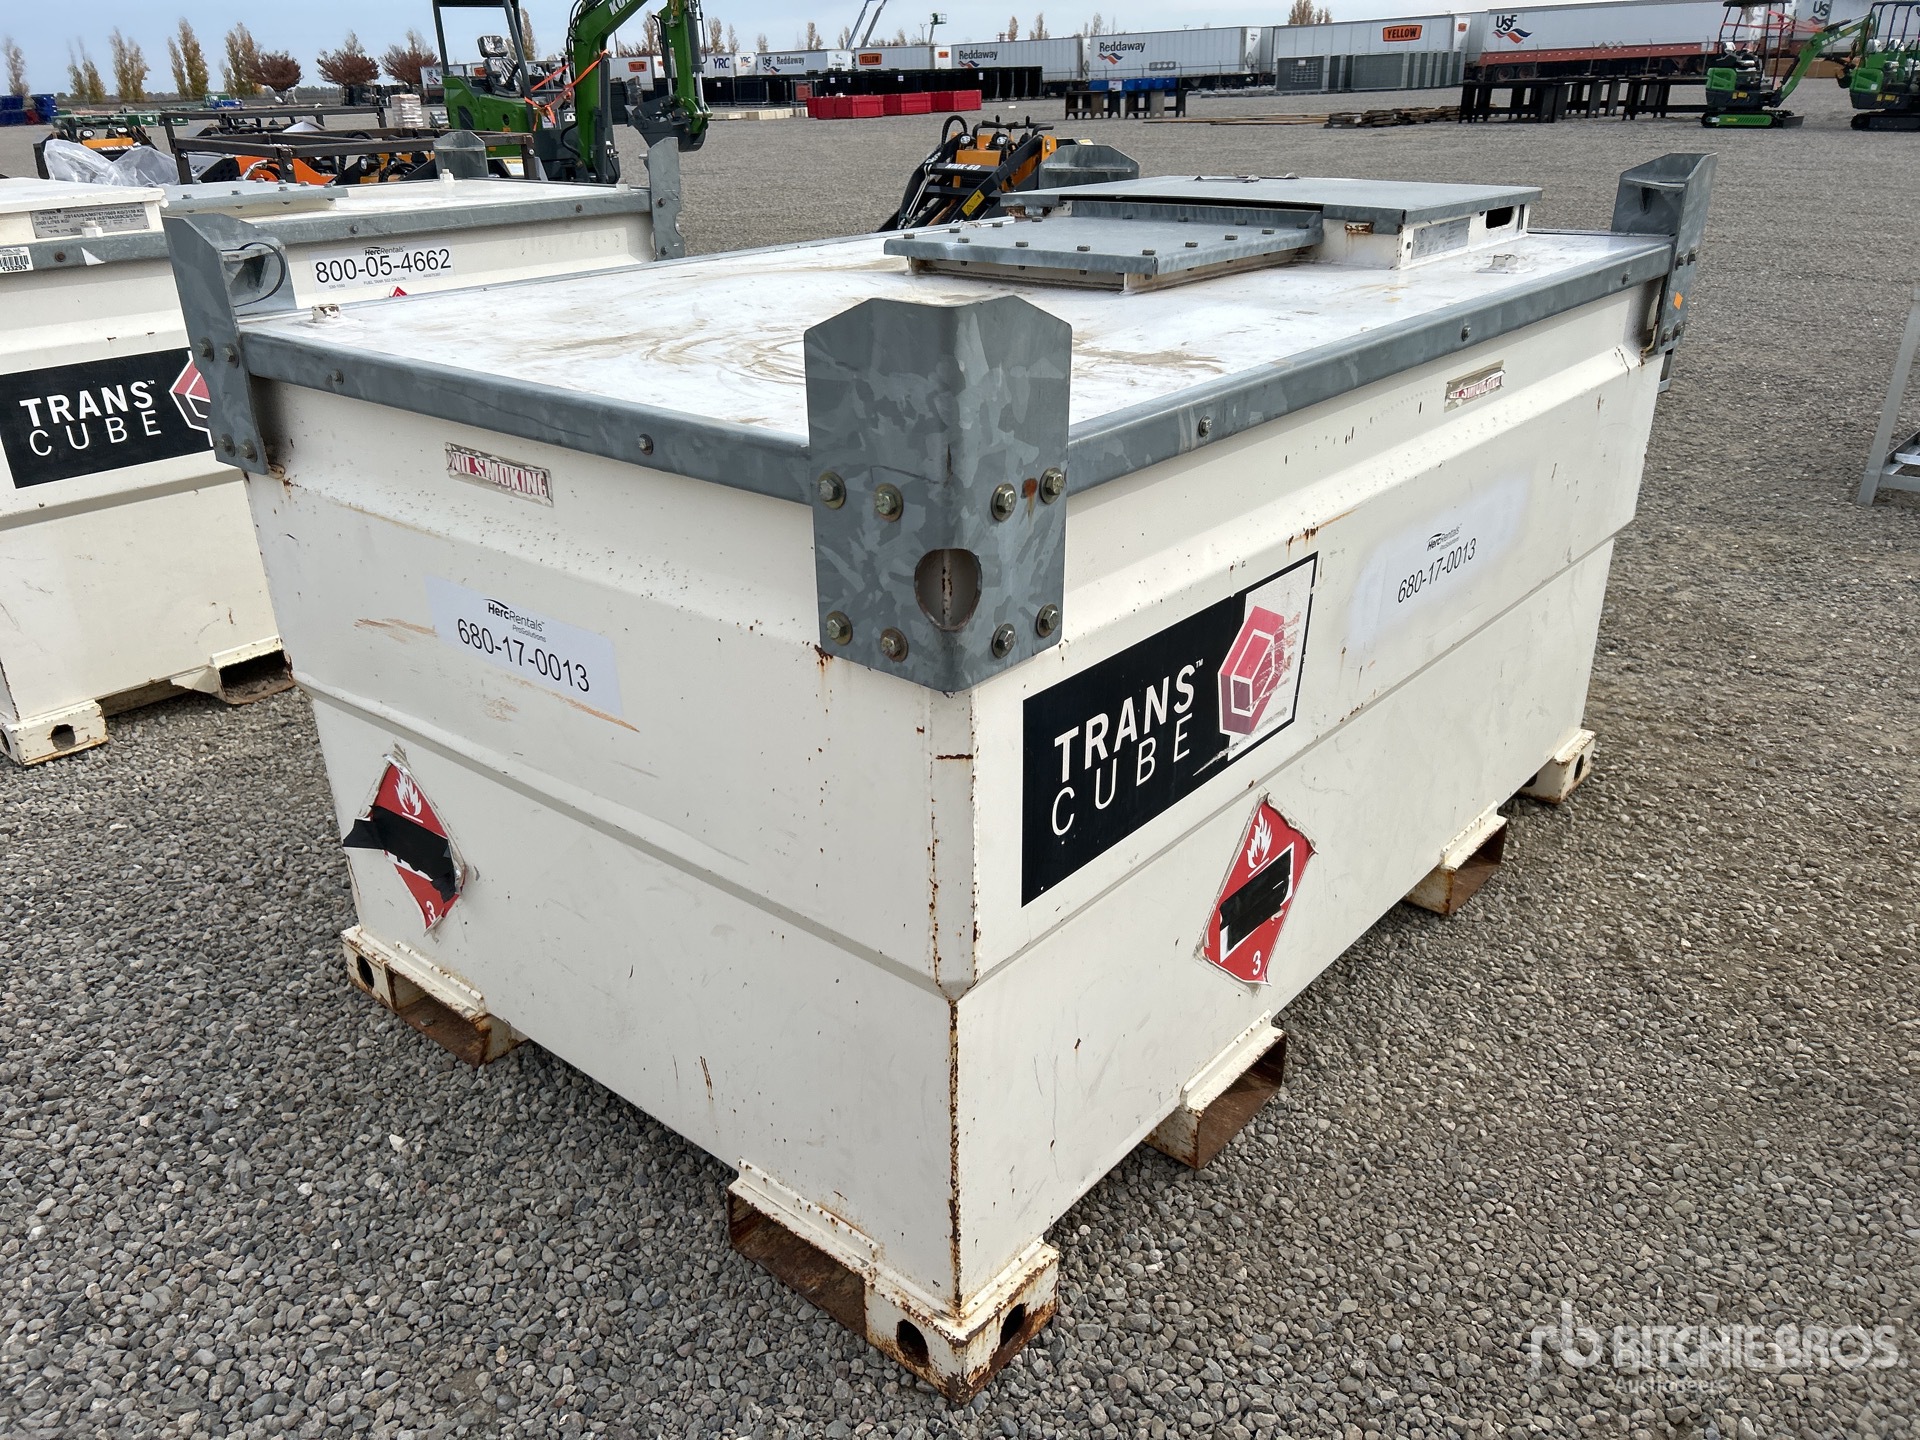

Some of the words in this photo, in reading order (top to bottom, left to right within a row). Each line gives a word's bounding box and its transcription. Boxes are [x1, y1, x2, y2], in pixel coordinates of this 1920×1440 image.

[1387, 27, 1418, 39] YELLOW
[1496, 14, 1517, 31] USF
[958, 49, 998, 61] Reddaway
[1099, 41, 1146, 53] Reddaway
[713, 57, 730, 69] YRC
[776, 55, 805, 66] Reddaway
[315, 248, 452, 284] 800-05-4662
[29, 409, 162, 456] CUBE
[474, 457, 548, 497] SMOKING
[1397, 537, 1477, 604] 680-17-0013
[488, 602, 544, 632] HercRentals
[457, 618, 590, 693] 680-17-0013
[1051, 712, 1193, 837] CUBE
[425, 900, 437, 923] 3
[1252, 950, 1262, 976] 3
